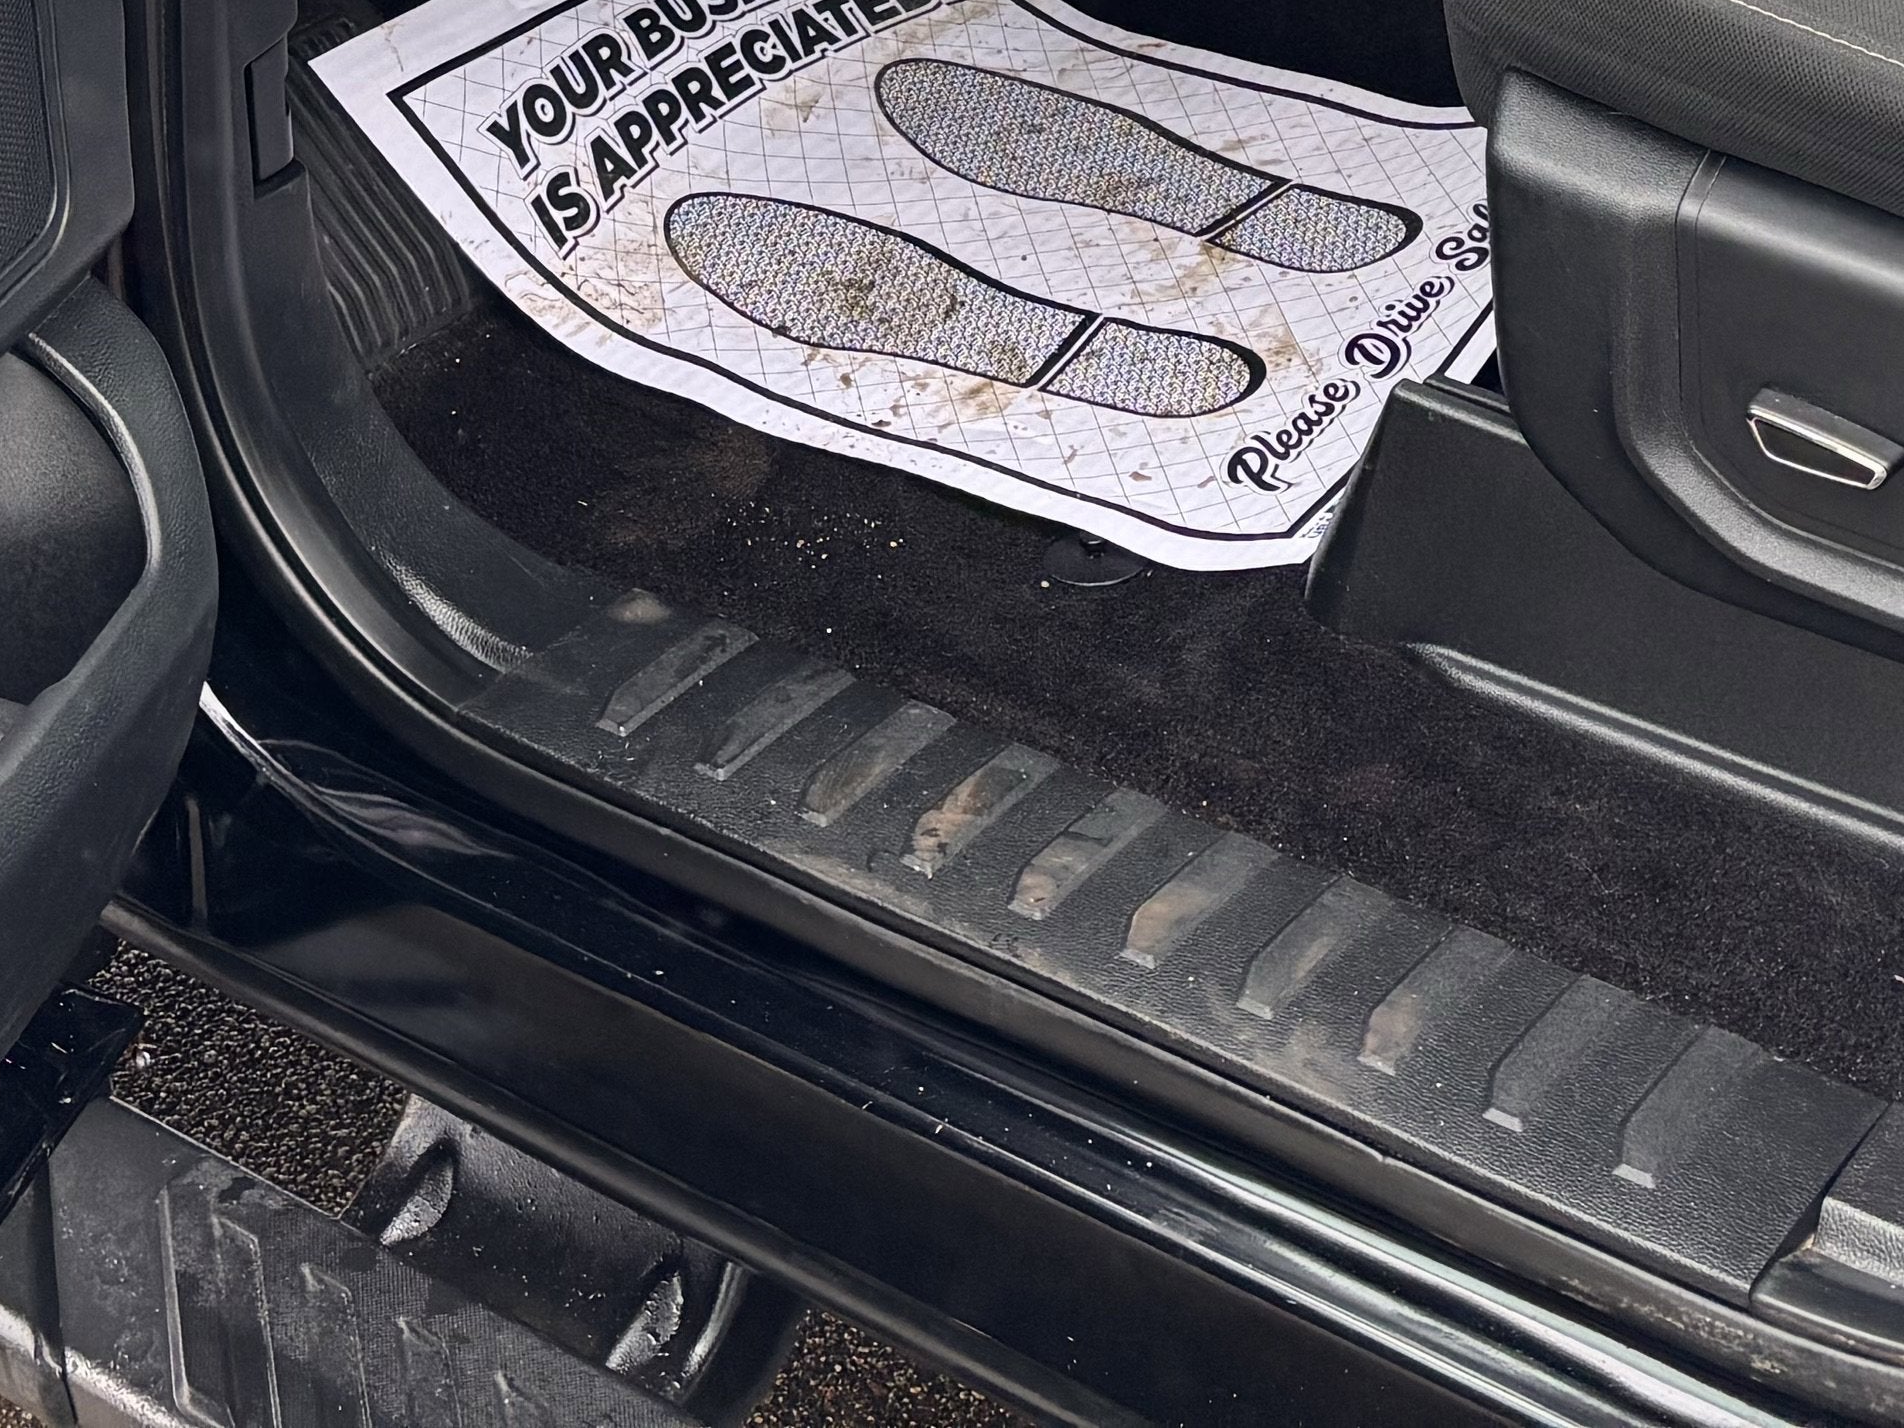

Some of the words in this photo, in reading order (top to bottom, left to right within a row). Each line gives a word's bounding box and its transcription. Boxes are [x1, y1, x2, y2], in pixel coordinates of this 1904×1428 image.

[485, 31, 638, 171] YOUR
[529, 170, 594, 250] IS
[1226, 379, 1357, 492] Please
[1345, 275, 1453, 380] Drive
